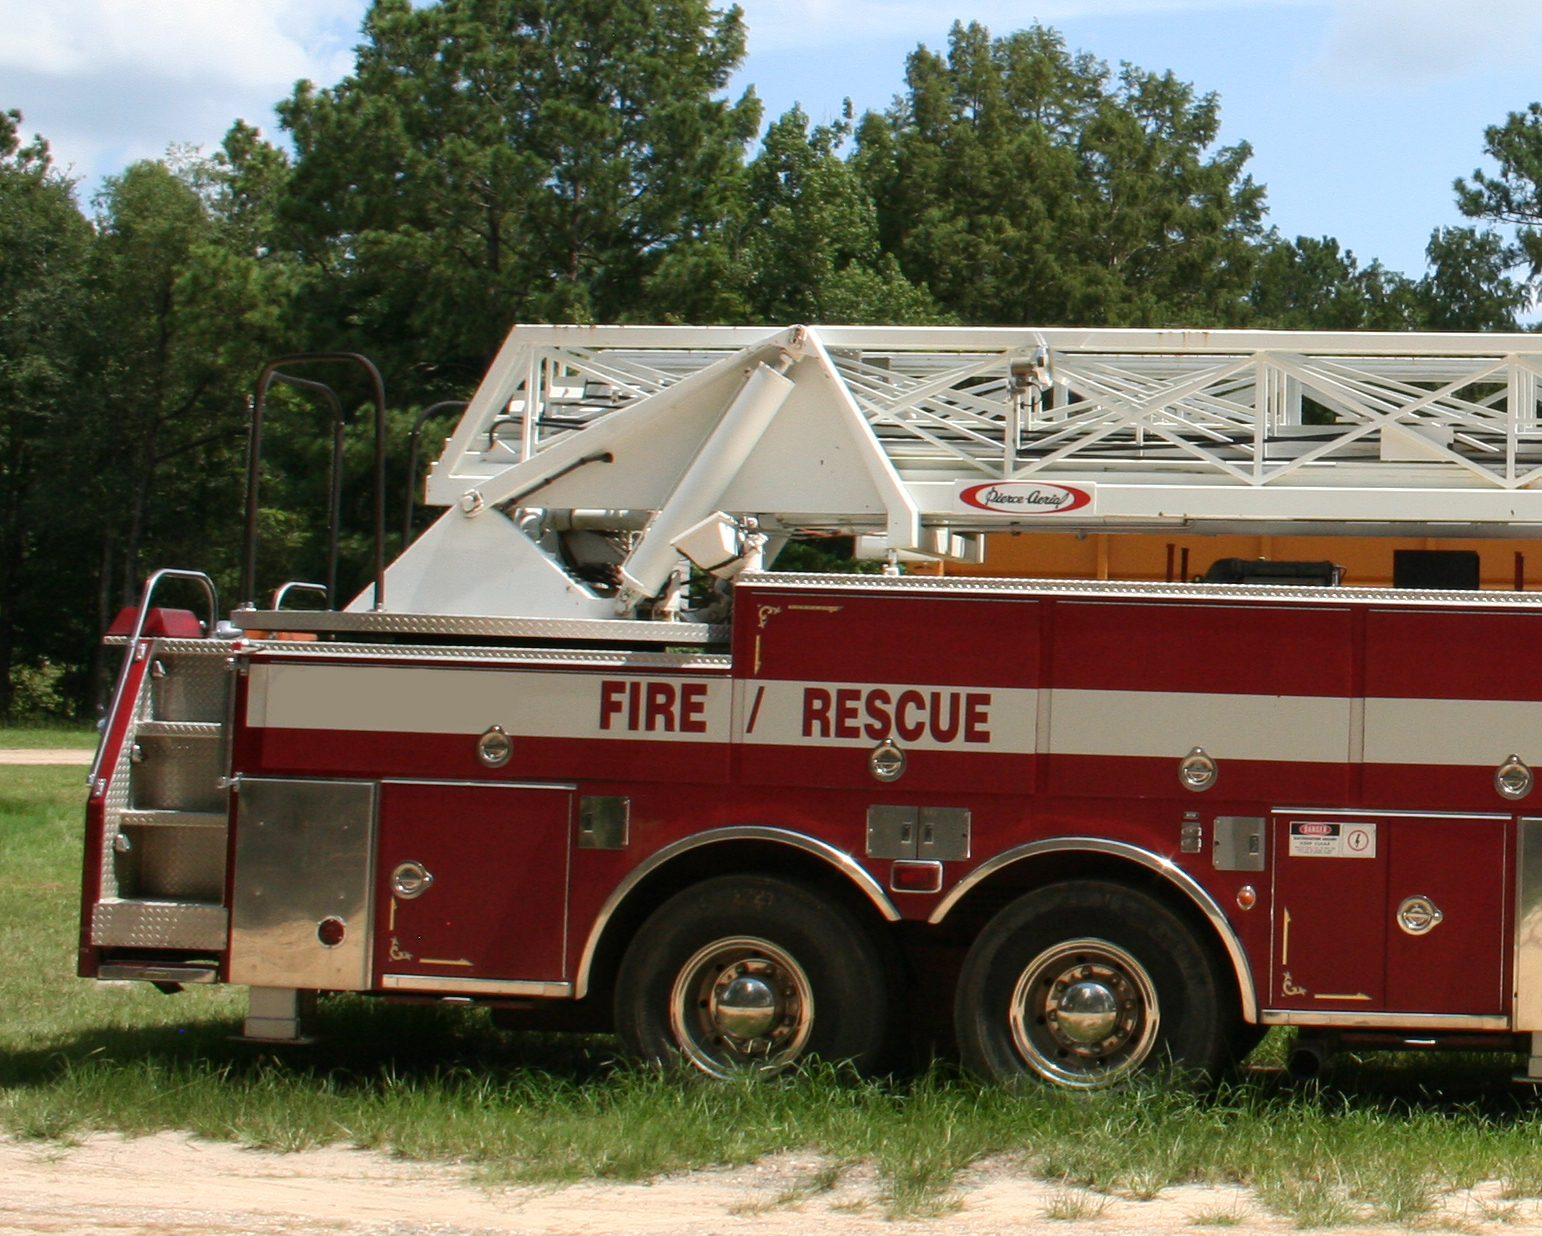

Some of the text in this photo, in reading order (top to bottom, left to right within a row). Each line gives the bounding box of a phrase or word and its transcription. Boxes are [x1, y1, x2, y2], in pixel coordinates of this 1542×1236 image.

[600, 680, 992, 744] FIRE / RESCUE
